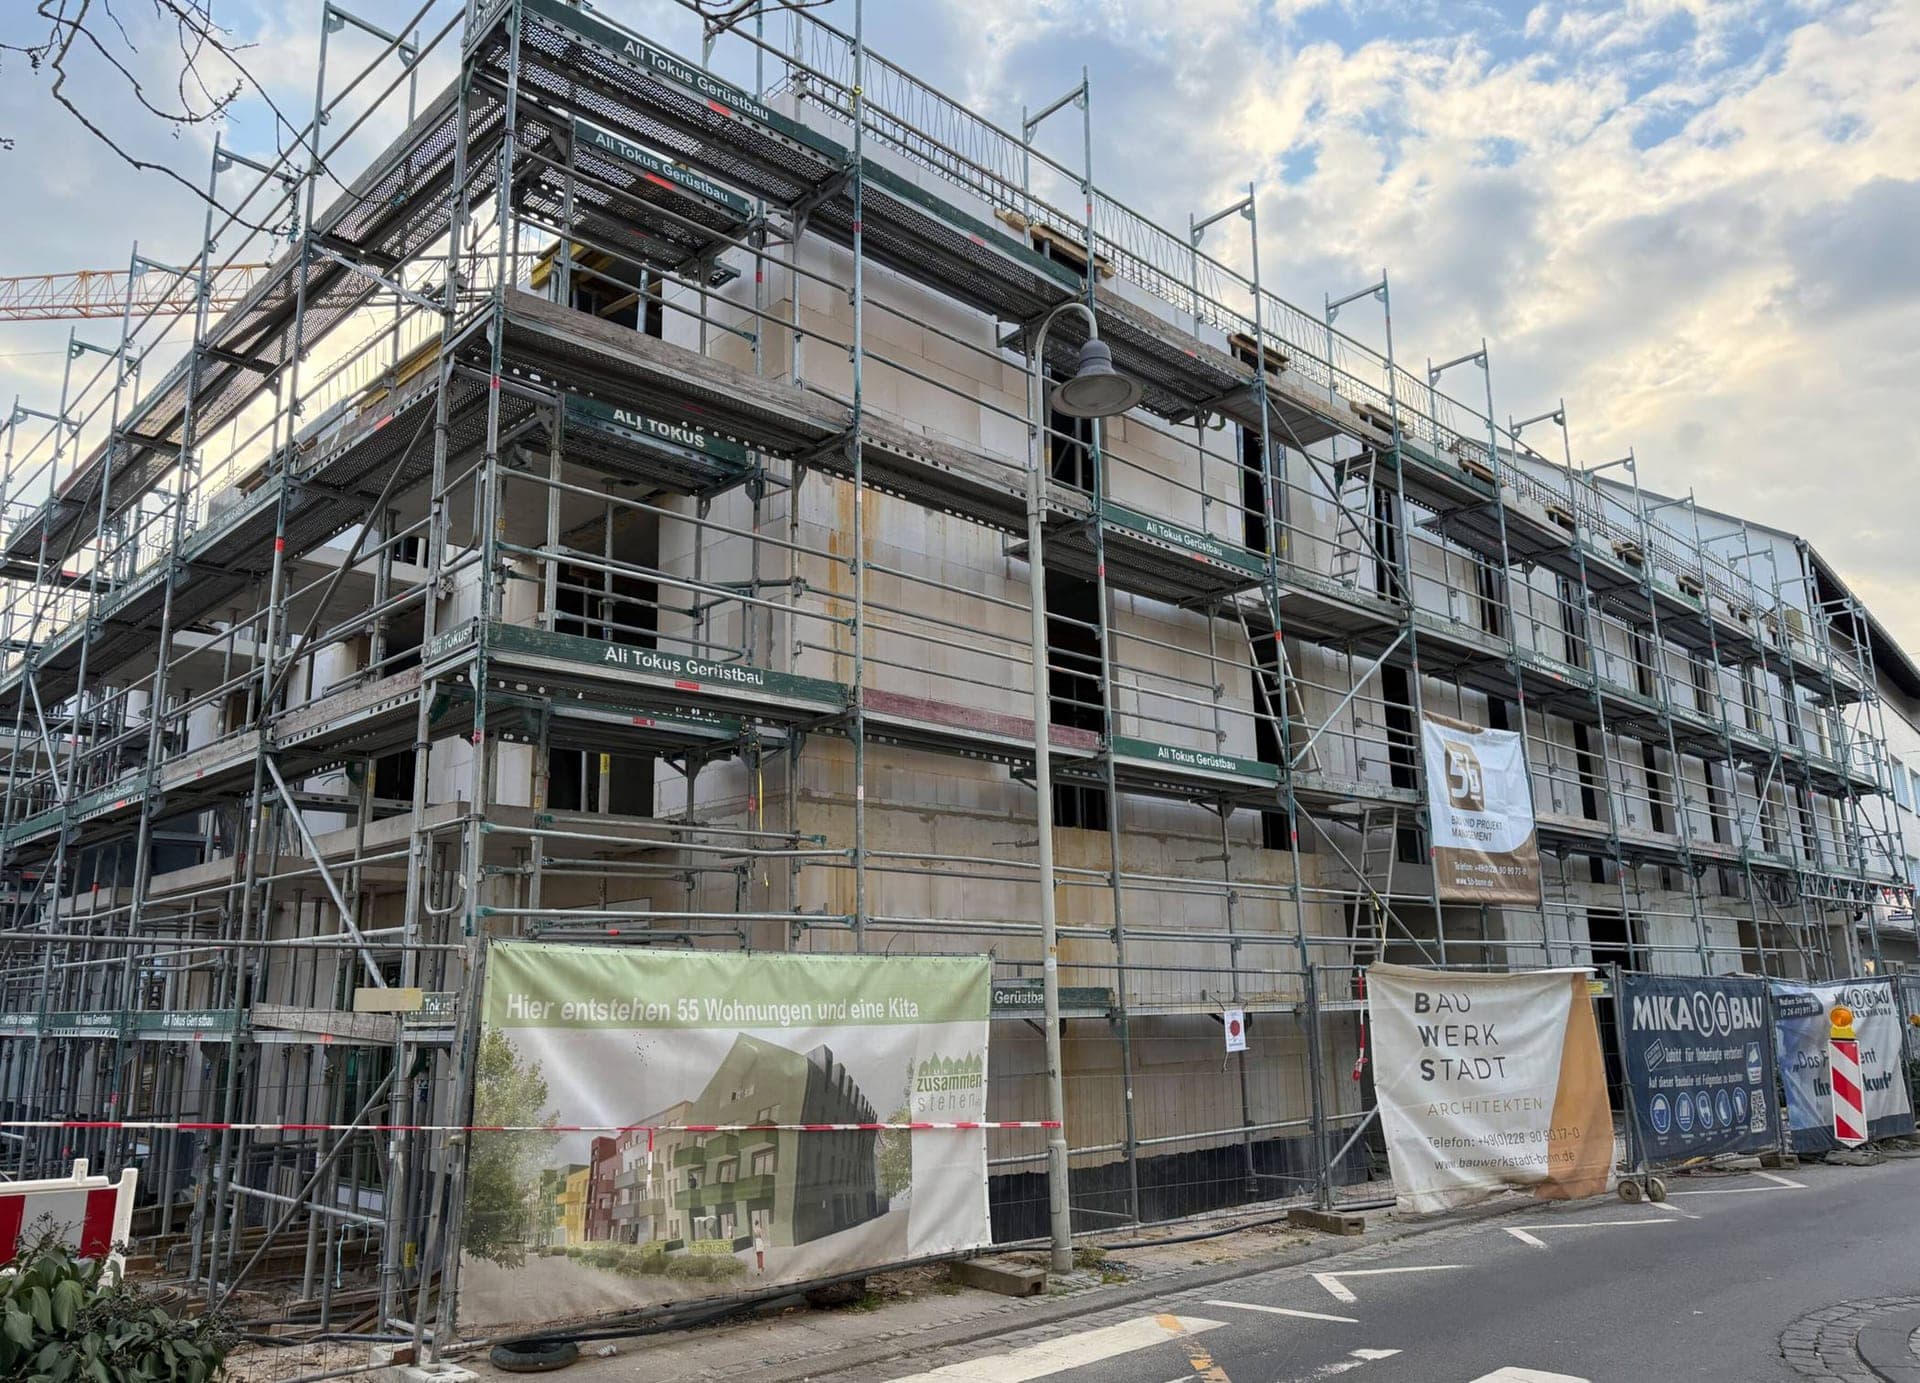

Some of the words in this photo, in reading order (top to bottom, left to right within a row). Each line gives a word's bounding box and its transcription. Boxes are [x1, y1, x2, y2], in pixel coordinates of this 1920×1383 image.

[624, 40, 644, 60] Ali
[651, 51, 693, 83] Tokus
[698, 76, 769, 121] Gerüstbau
[595, 134, 614, 150] Ali
[618, 142, 658, 170] Tokus
[663, 164, 728, 203] Gerüstbau
[647, 419, 705, 448] TOKUS
[1159, 525, 1182, 542] Tokus
[605, 646, 627, 663] Ali
[632, 650, 681, 672] Tokus
[1158, 747, 1169, 758] Ali
[1170, 749, 1195, 763] Tokus
[1196, 754, 1236, 770] Gerüstbau
[506, 992, 554, 1020] Hier
[561, 997, 670, 1022] entstehen
[677, 998, 699, 1022] 55
[705, 997, 812, 1026] Wohnungen
[818, 998, 847, 1021] und
[851, 999, 884, 1019] eine
[889, 997, 919, 1019] Kita
[994, 990, 1044, 1005] Gerüstba
[1415, 992, 1471, 1014] BAU
[1632, 995, 1695, 1031] MIKA
[1729, 996, 1762, 1030] BAU
[1418, 1024, 1498, 1047] WERK
[1420, 1056, 1505, 1081] STADT
[916, 1073, 982, 1093] zusammen
[917, 1092, 975, 1113] stehen
[1427, 1097, 1542, 1117] ARCHITEKTEN
[1427, 1136, 1475, 1149] Telefon:
